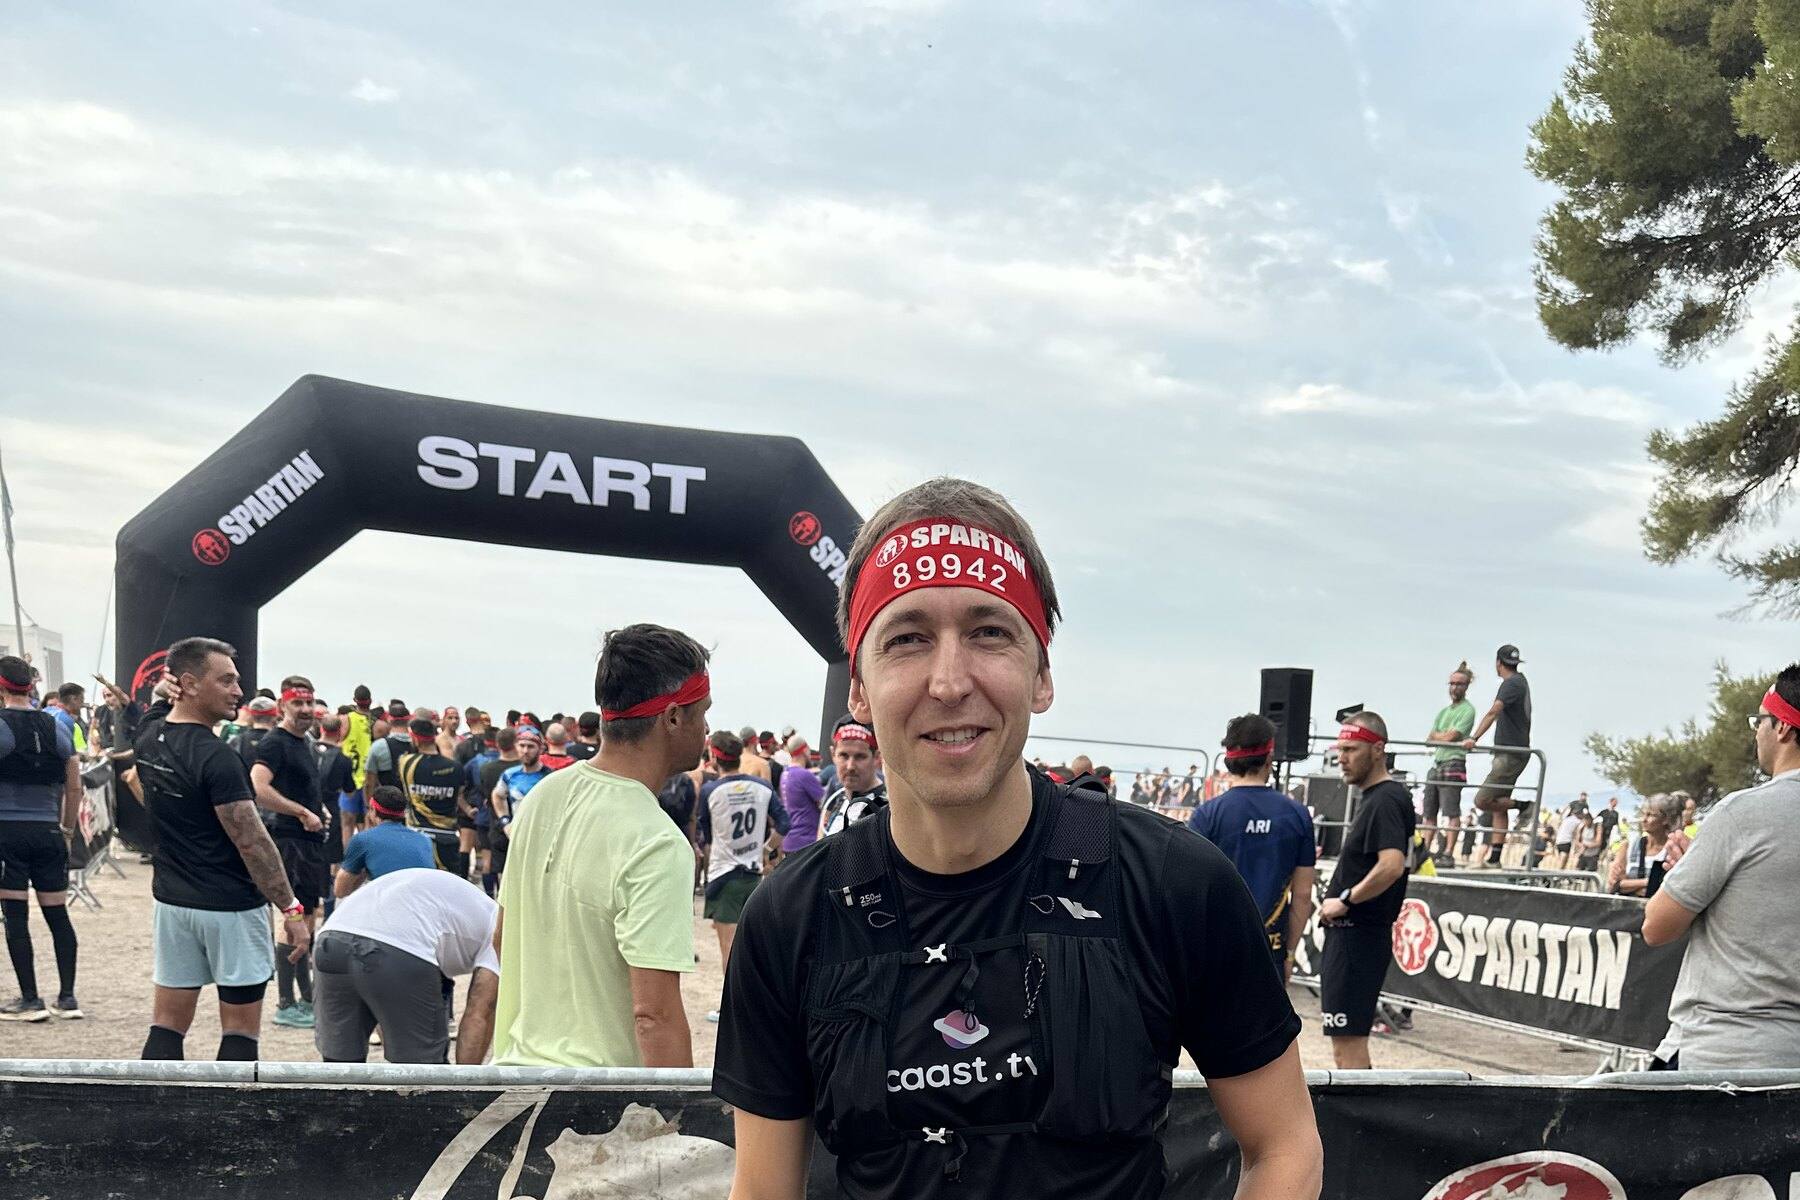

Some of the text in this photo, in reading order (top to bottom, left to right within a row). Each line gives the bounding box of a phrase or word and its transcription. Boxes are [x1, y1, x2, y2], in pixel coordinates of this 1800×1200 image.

[217, 449, 325, 546] SPARTAN
[417, 435, 707, 515] START
[893, 553, 1007, 592] 89942
[911, 524, 1027, 580] SPARTAN
[731, 807, 757, 840] 20
[1245, 819, 1271, 834] ARI
[1434, 911, 1632, 1010] SPARTAN
[1321, 1012, 1348, 1028] RG
